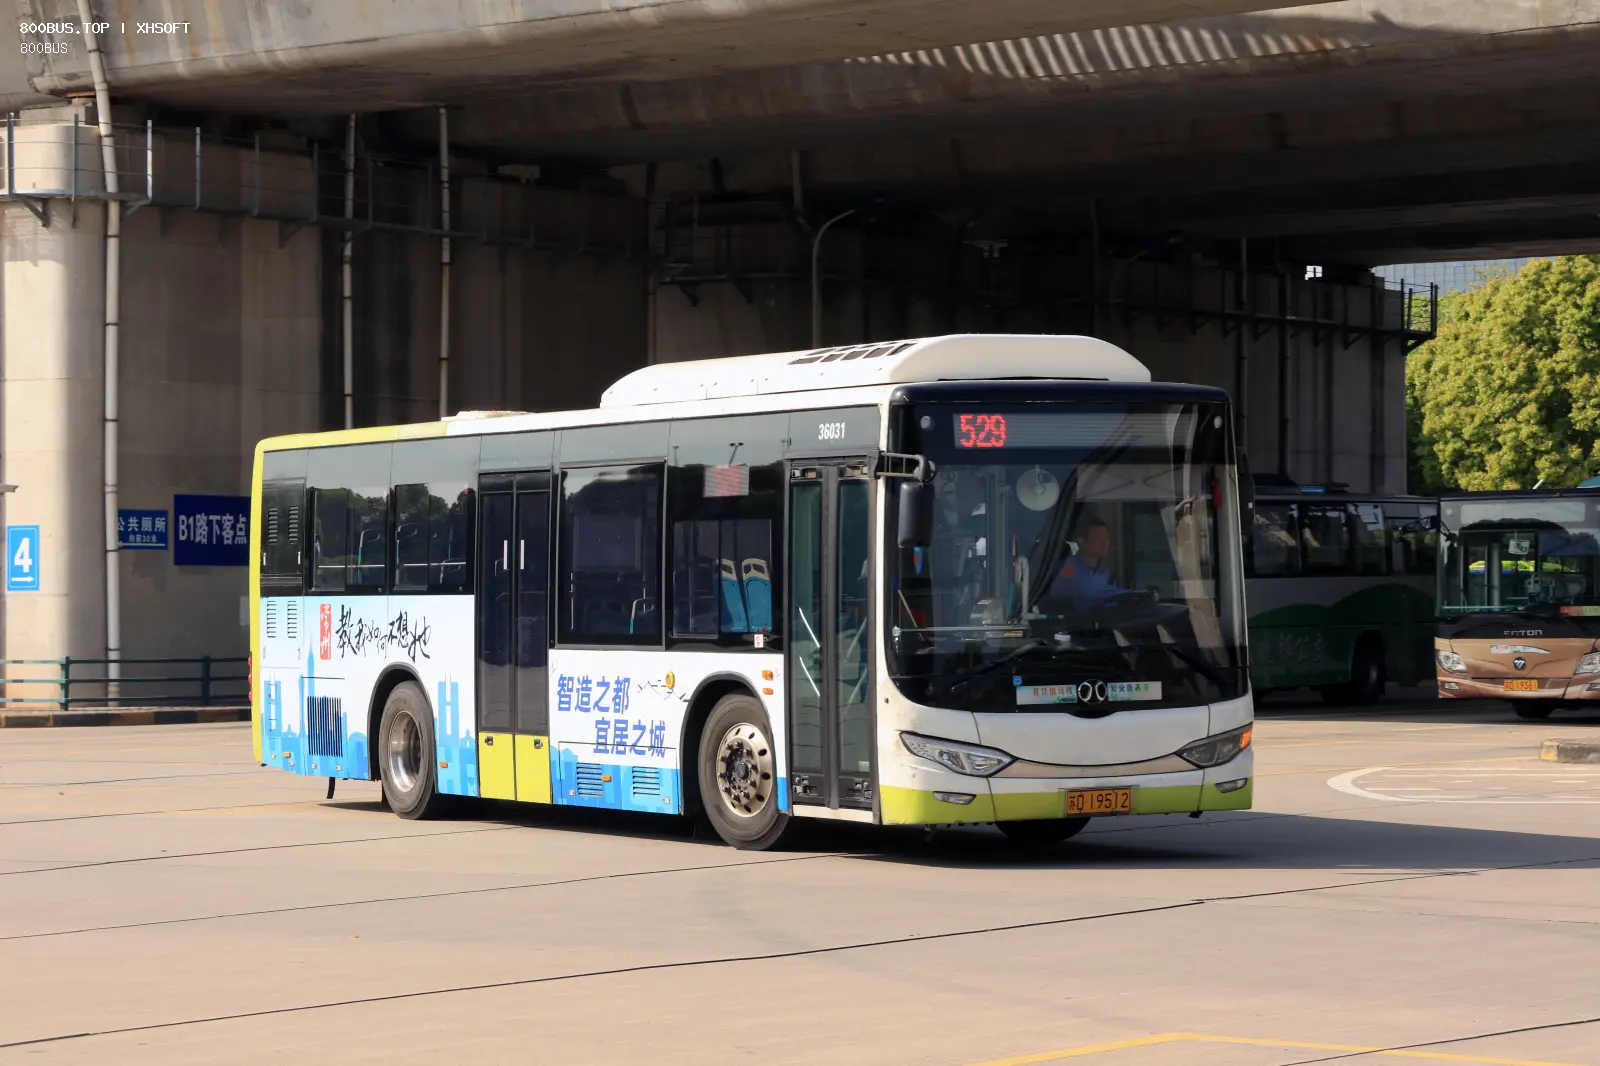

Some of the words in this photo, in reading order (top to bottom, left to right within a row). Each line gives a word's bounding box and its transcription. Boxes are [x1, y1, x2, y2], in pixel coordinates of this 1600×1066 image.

[818, 422, 846, 440] 36031
[959, 413, 1007, 449] 529
[118, 516, 166, 533] 公共厕所
[178, 512, 248, 546] B1路下客点
[14, 537, 33, 573] 4
[557, 674, 631, 715] 智造之都
[593, 717, 666, 758] 宜居之城
